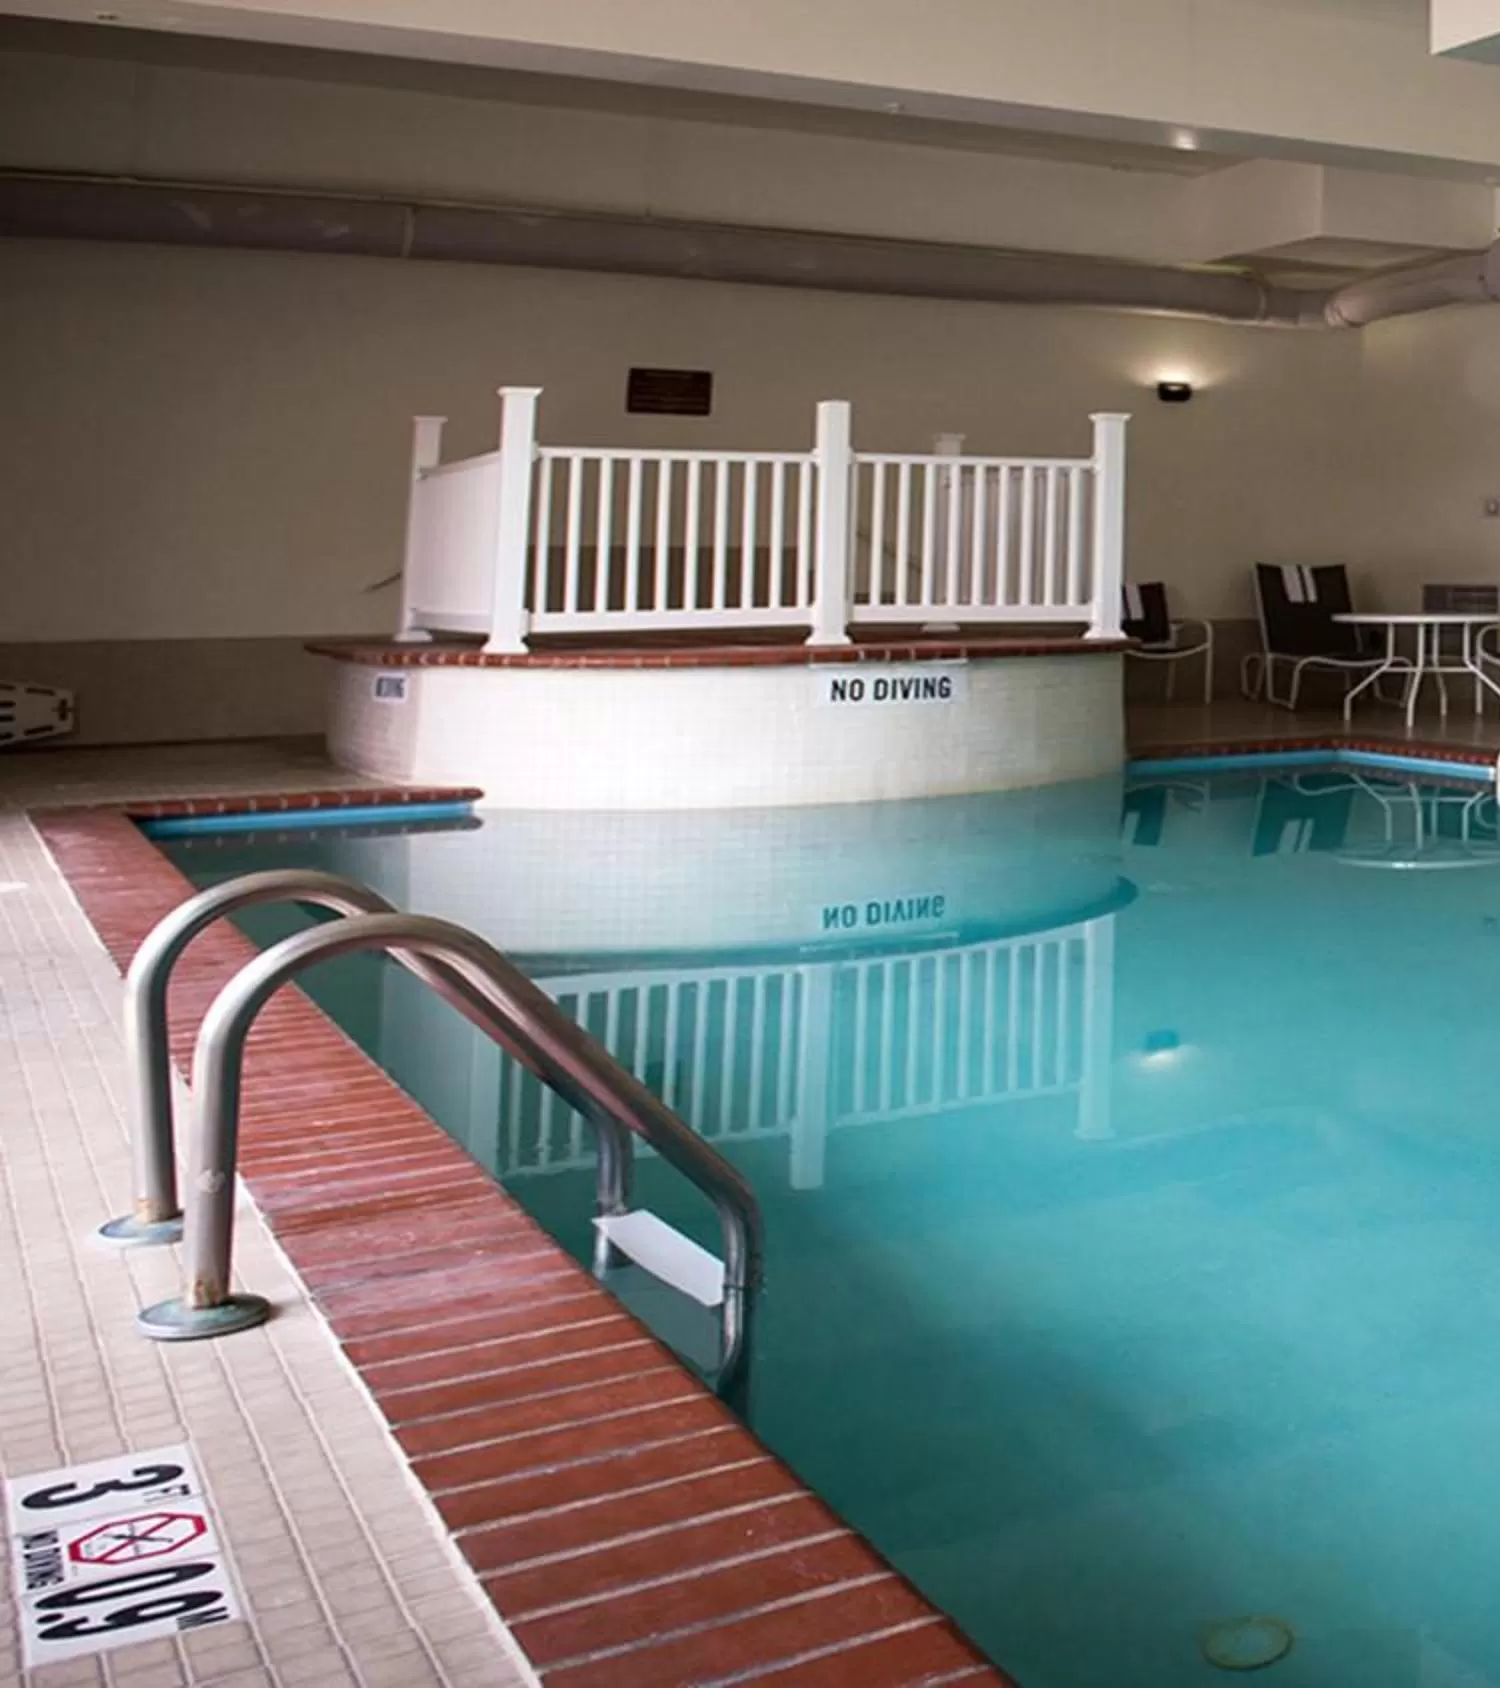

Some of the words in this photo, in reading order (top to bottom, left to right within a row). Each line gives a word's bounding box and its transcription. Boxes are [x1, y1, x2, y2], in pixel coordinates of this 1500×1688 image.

[830, 678, 865, 702] NO
[873, 675, 952, 702] DIVING
[21, 1463, 184, 1510] 3
[23, 1529, 59, 1550] NO
[24, 1546, 65, 1590] DIVING
[34, 1562, 224, 1641] 0.9
